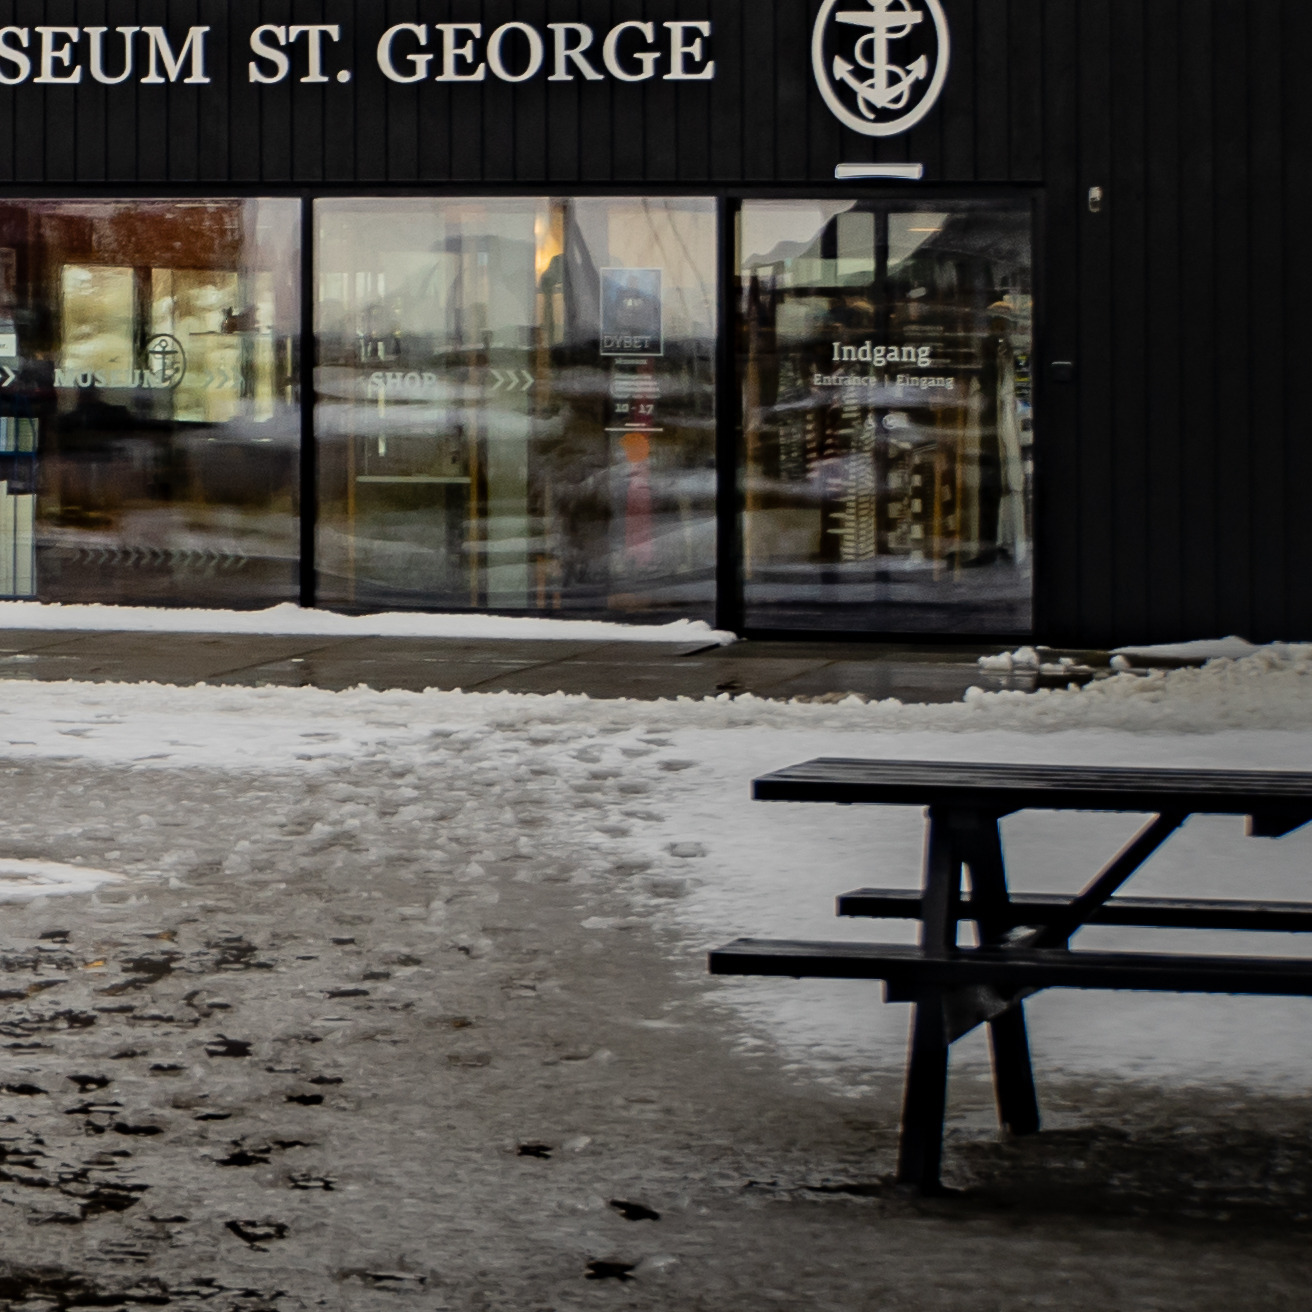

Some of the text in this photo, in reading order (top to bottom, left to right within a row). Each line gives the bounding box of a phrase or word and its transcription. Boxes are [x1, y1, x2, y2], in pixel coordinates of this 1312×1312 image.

[248, 24, 351, 84] ST.
[376, 20, 716, 83] GEORGE
[832, 340, 932, 367] Indgang
[369, 371, 437, 390] SHOP
[813, 373, 877, 386] Entrance
[896, 374, 955, 390] Eingang
